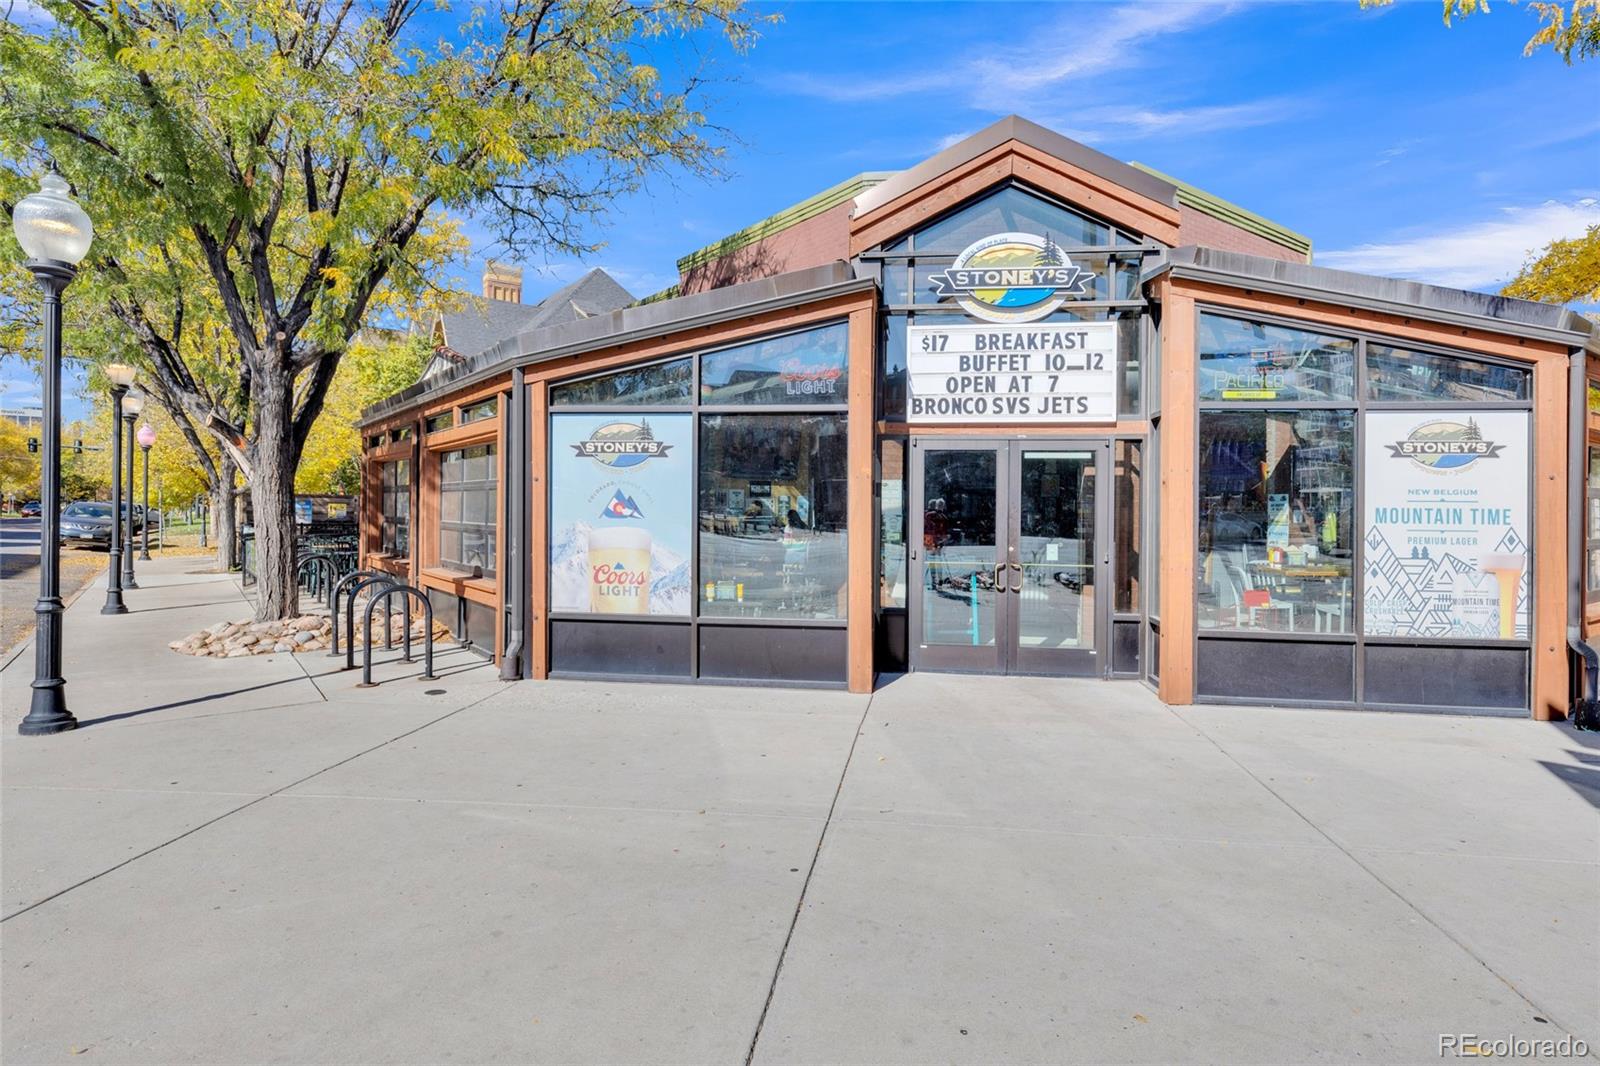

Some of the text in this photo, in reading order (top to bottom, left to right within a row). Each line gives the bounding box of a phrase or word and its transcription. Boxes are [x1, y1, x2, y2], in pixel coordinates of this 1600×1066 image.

[956, 269, 1069, 286] STONEY'S
[922, 332, 1088, 352] $17 BREAKFAST
[959, 354, 1031, 372] BUFFET
[786, 379, 836, 395] LIGHT
[946, 375, 1059, 393] OPEN AT 7
[1038, 396, 1088, 414] JETS
[585, 442, 658, 453] STONEY'S
[1402, 442, 1487, 453] STONEY'S
[1407, 488, 1479, 496] NEW BELGIUM
[1375, 507, 1512, 526] MOUNTAIN TIME
[1407, 536, 1479, 546] PREMIUM LAGER
[592, 564, 646, 585] Coors
[599, 585, 640, 597] LIGHT
[1452, 597, 1484, 606] MOUNTAIN
